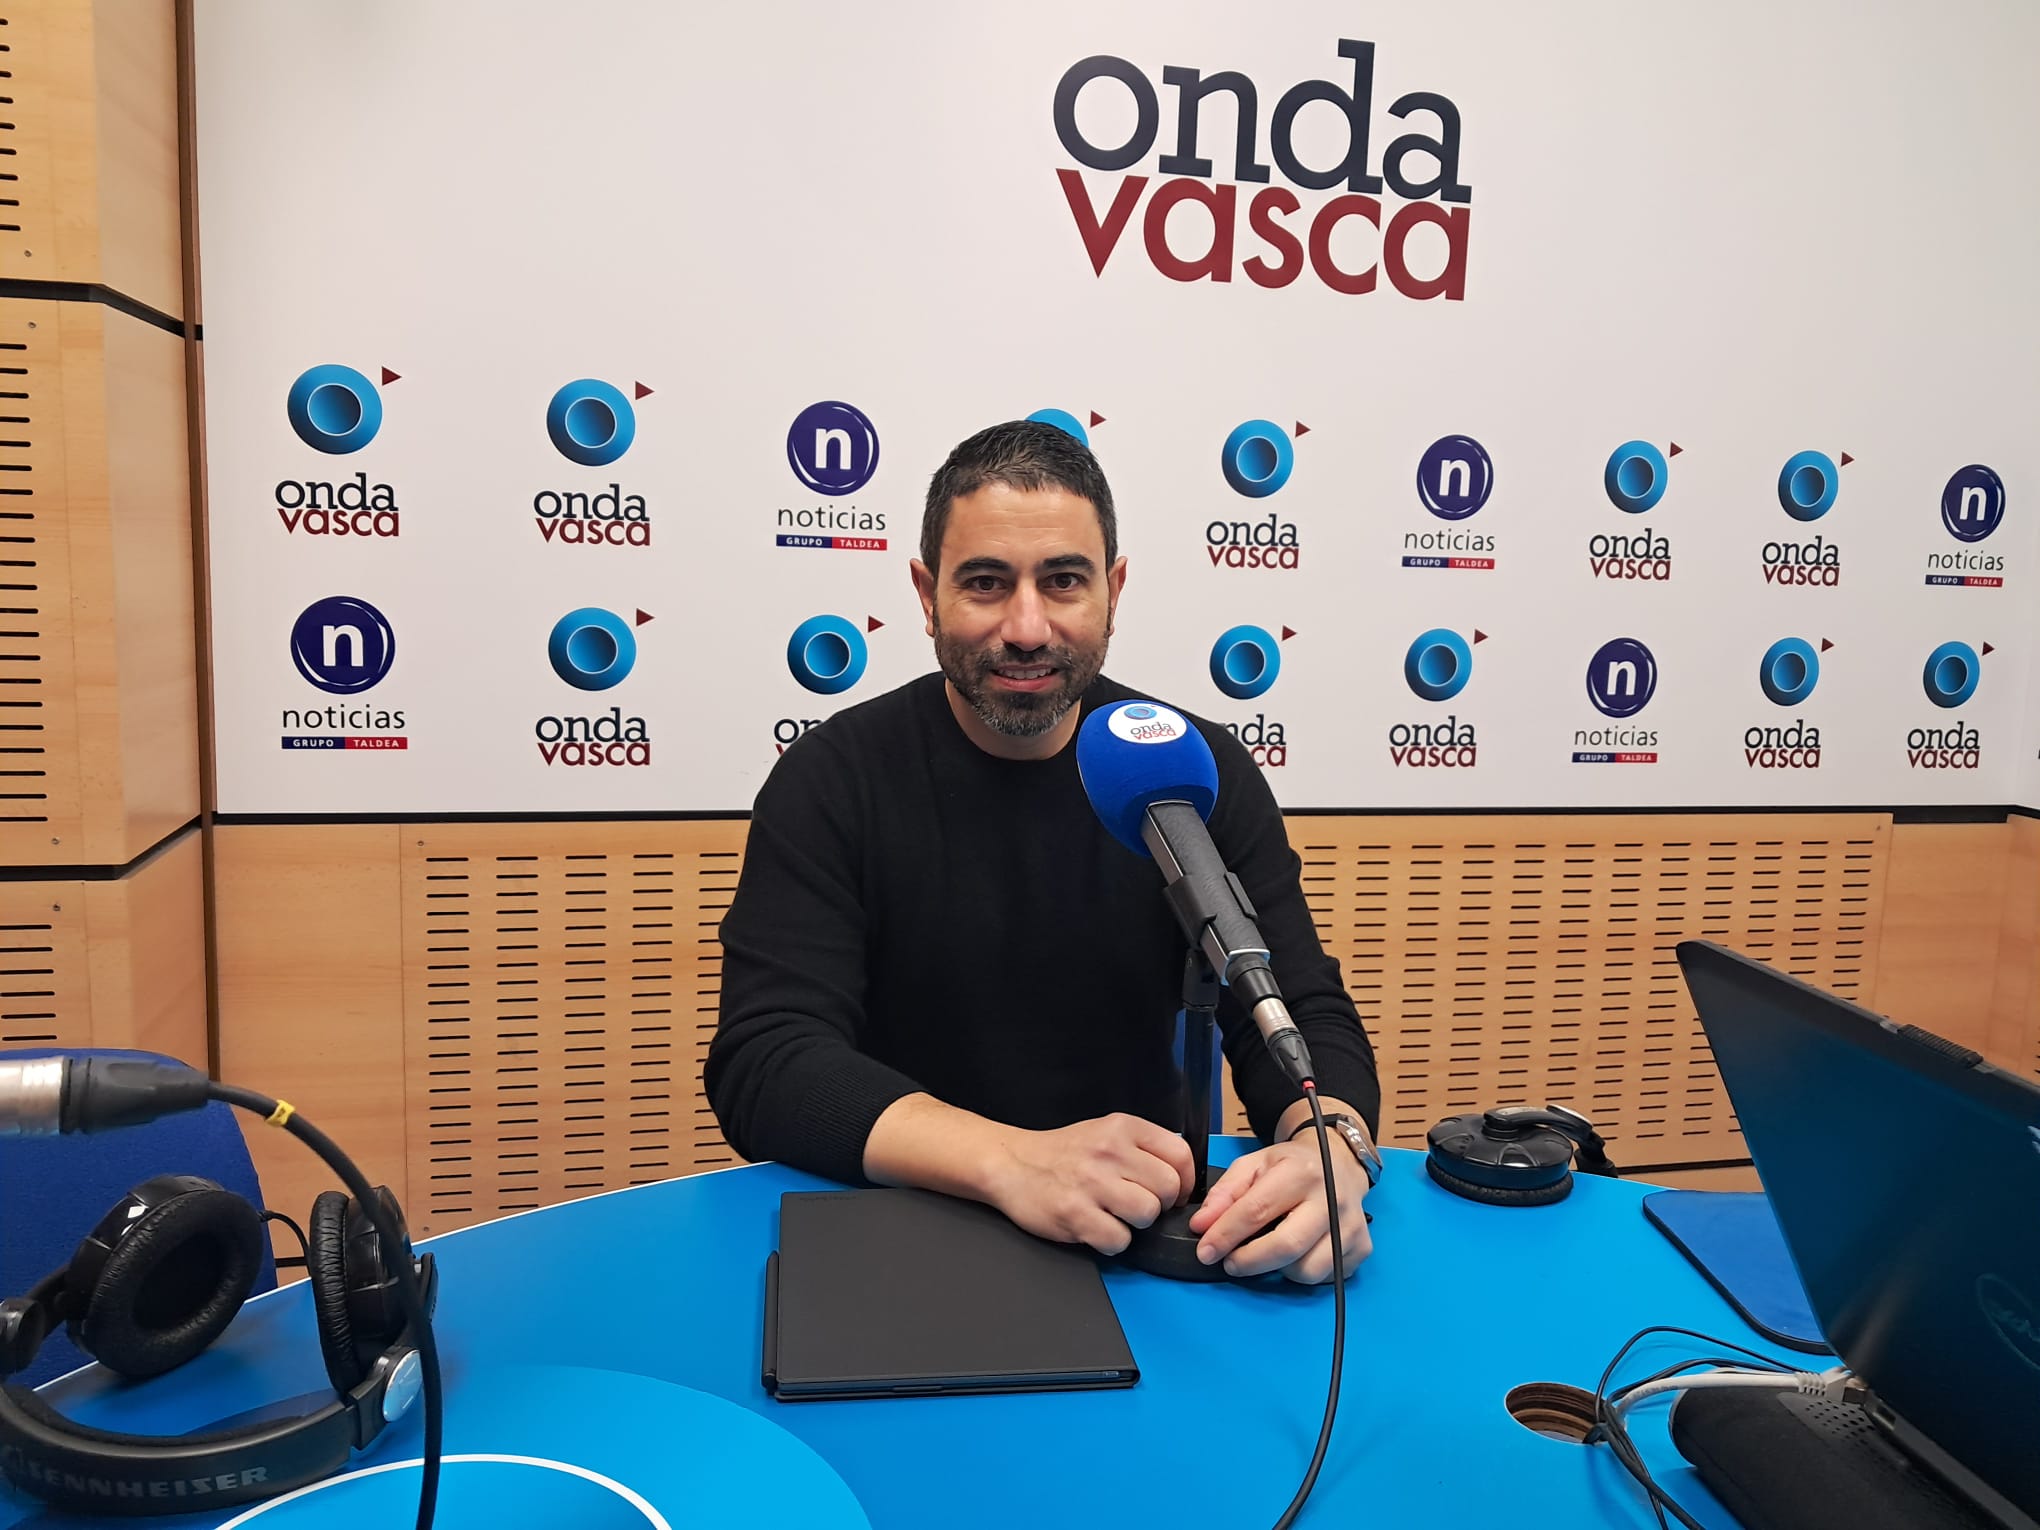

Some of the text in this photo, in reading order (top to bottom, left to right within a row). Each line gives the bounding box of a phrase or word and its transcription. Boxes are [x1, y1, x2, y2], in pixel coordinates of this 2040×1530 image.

[1053, 38, 1472, 203] onda
[1055, 167, 1471, 301] vasca
[815, 428, 852, 470] n
[275, 472, 398, 512] onda
[1439, 459, 1471, 497] n
[533, 484, 650, 522] onda
[1960, 486, 1987, 521] n
[278, 509, 400, 538] vasca
[777, 504, 886, 531] noticias
[1206, 513, 1299, 548] onda
[536, 519, 651, 547] vasca
[786, 536, 880, 549] GRUPO TALDEA
[1404, 528, 1495, 551] noticias
[1589, 527, 1671, 561] onda
[1207, 545, 1300, 570] vasca
[1409, 558, 1489, 568] GRUPO TALDEA
[1761, 535, 1840, 567] onda
[1927, 549, 2004, 571] noticias
[1590, 557, 1672, 581] vasca
[1762, 562, 1840, 587] vasca
[323, 624, 364, 667] n
[1606, 661, 1637, 696] n
[282, 703, 406, 729] noticias
[535, 707, 650, 744] onda
[1130, 721, 1172, 735] onda
[1222, 714, 1287, 746] da
[293, 739, 400, 748] GRUPO TALDEA
[1133, 729, 1177, 740] vasca
[1389, 715, 1476, 748] onda
[1574, 725, 1658, 746] noticias
[1744, 719, 1821, 750] onda
[1907, 720, 1981, 751] onda
[538, 741, 651, 767] vasca
[1390, 745, 1477, 768] vasca
[1744, 746, 1821, 769] vasca
[1907, 747, 1981, 769] vasca
